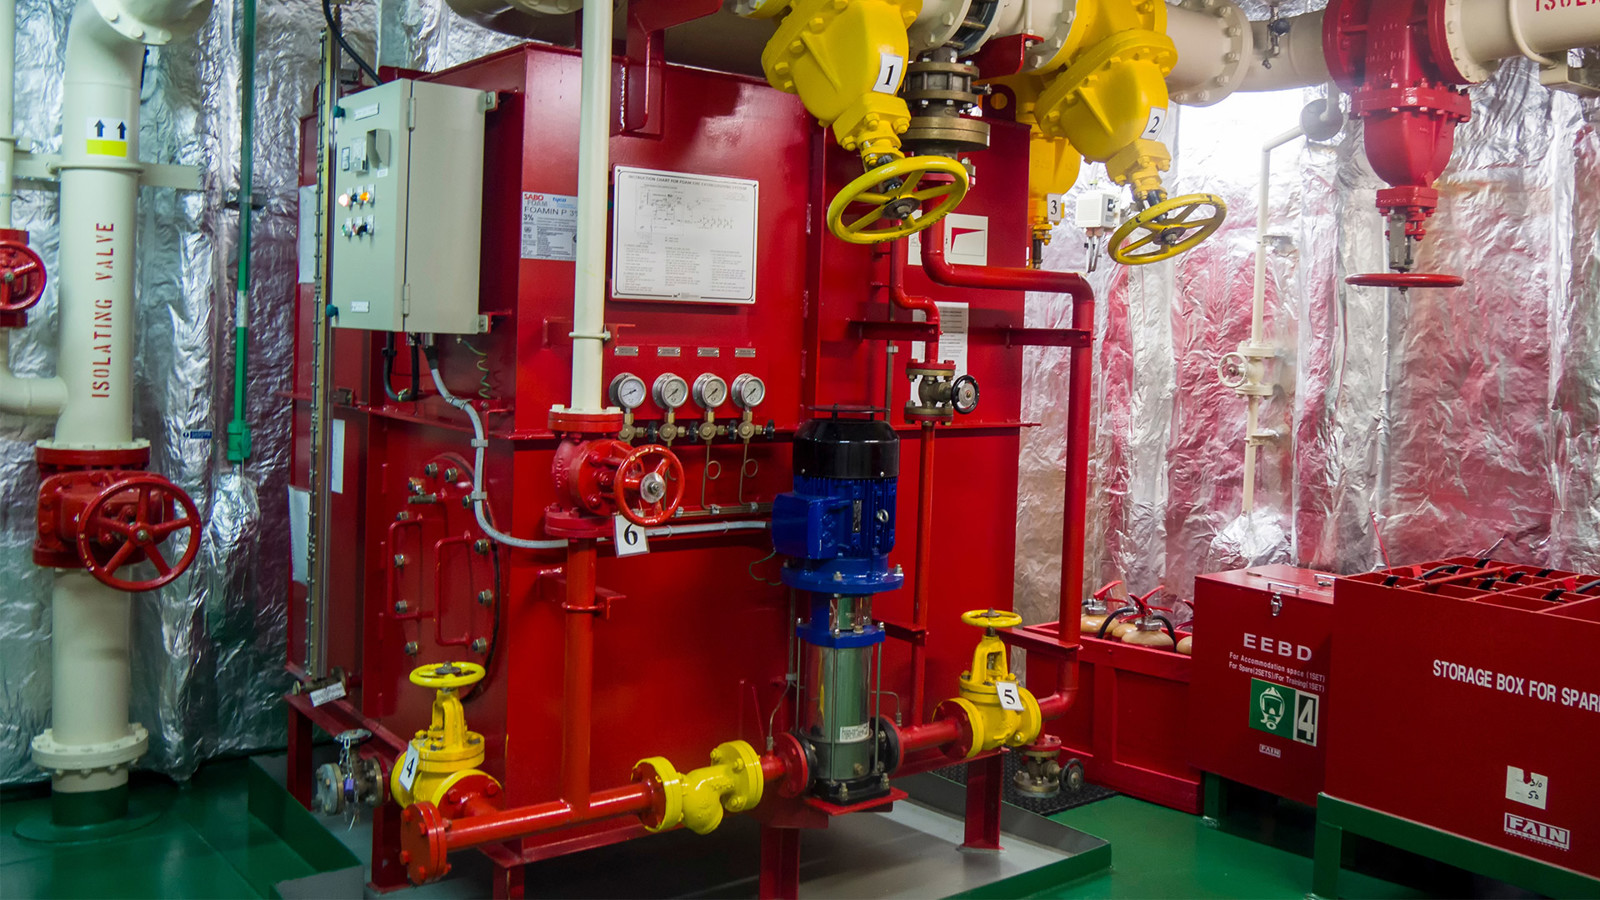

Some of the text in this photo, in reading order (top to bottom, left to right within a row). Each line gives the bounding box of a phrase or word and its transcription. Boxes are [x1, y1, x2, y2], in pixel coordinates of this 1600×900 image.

[884, 64, 894, 86] 1
[1149, 116, 1160, 133] 2
[524, 193, 544, 201] SABO
[1051, 200, 1058, 215] 3
[524, 206, 559, 215] FOAMIN
[95, 223, 114, 281] VALVE
[91, 298, 112, 399] ISOLATING
[624, 523, 638, 546] 6
[1243, 632, 1312, 661] EEBD
[1228, 661, 1238, 669] For
[1229, 651, 1239, 660] For
[1240, 654, 1285, 672] Accommodation
[1286, 667, 1304, 678] space
[1432, 658, 1493, 688] STORAGE
[1496, 672, 1525, 696] BOX
[1528, 679, 1557, 703] FOR
[1004, 689, 1015, 704] 5
[1298, 699, 1314, 740] 4
[1260, 745, 1280, 757] FAIN
[406, 758, 414, 778] 4
[1509, 815, 1566, 844] FAIN
